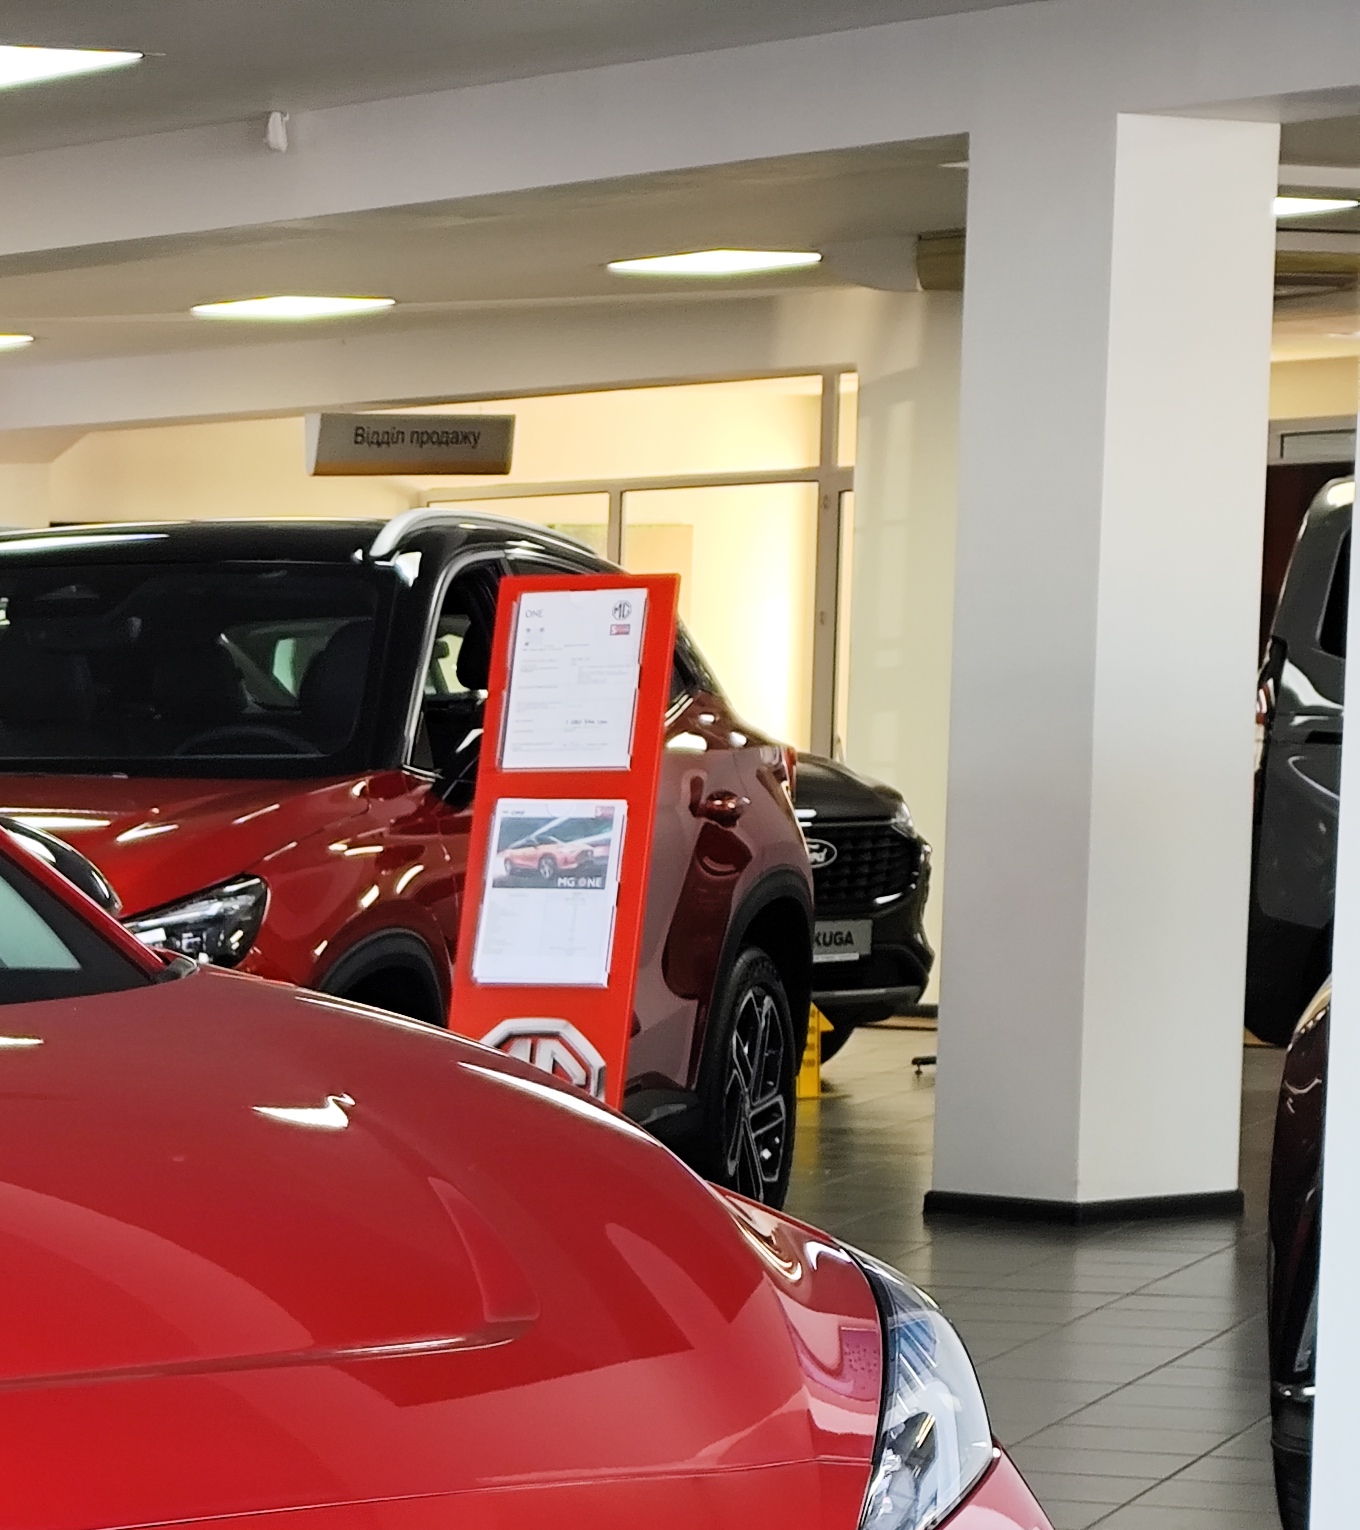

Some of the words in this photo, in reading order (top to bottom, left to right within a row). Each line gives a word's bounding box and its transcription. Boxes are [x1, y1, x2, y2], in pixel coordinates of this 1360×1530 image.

[353, 426, 405, 448] Відділ
[409, 429, 480, 449] продажу
[525, 609, 543, 618] ONE
[612, 602, 631, 619] MG
[557, 876, 575, 887] MG
[578, 877, 603, 887] ONE
